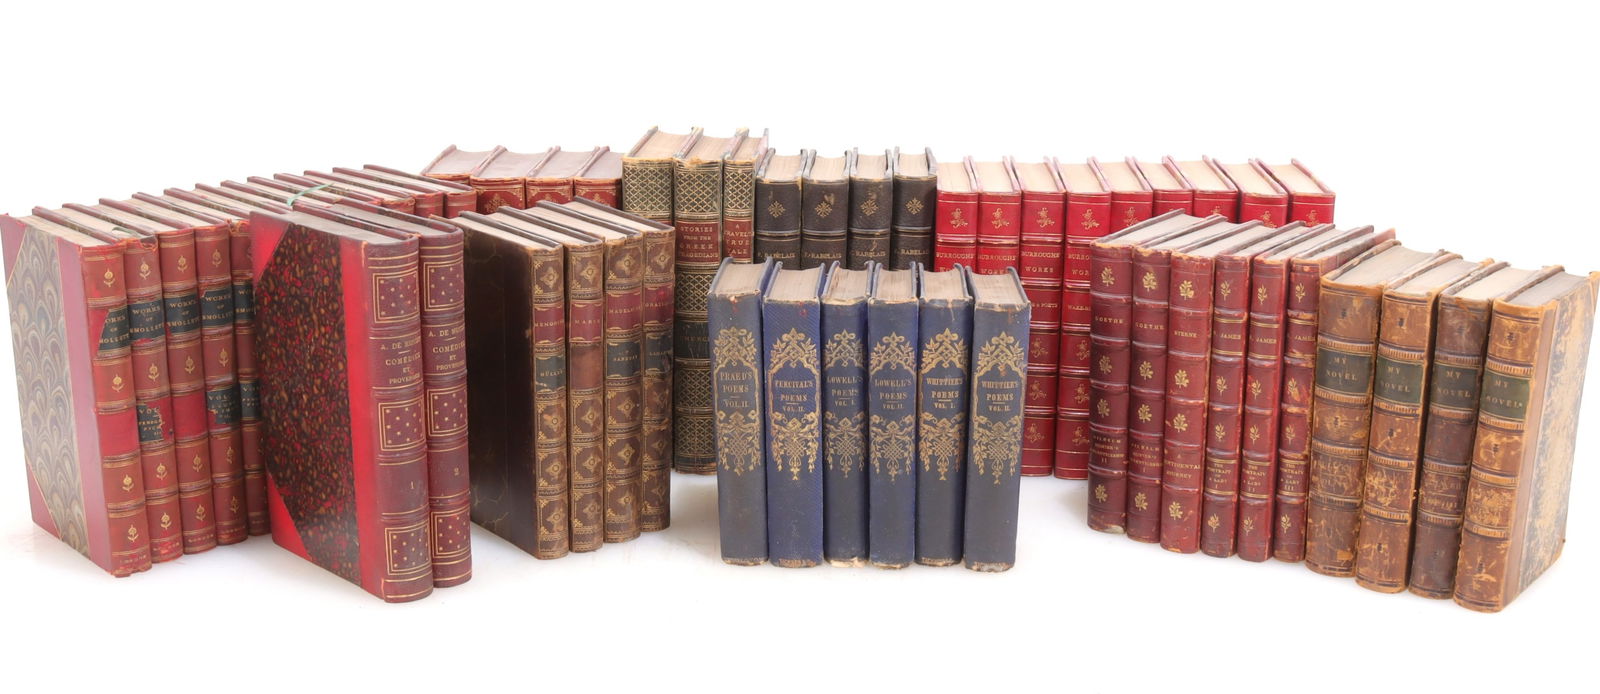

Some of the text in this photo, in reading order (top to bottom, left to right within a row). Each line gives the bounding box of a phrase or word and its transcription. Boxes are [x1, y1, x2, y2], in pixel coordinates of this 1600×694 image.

[1068, 253, 1090, 261] BURRO
[392, 342, 402, 350] DE
[1334, 356, 1348, 365] MY
[1386, 365, 1401, 375] MY
[720, 371, 752, 381] PRAED'S
[1326, 369, 1358, 382] NOVEL
[1446, 370, 1461, 380] MY
[775, 380, 814, 388] PERCIVAL'S
[874, 378, 912, 387] LOWELL'S
[1494, 380, 1509, 389] MY
[723, 385, 749, 393] POEMS
[831, 389, 859, 397] POEMS
[1436, 387, 1471, 399] NOVEL
[879, 392, 908, 400] POEMS
[931, 390, 959, 399] POEMS
[986, 393, 1014, 401] POEMS
